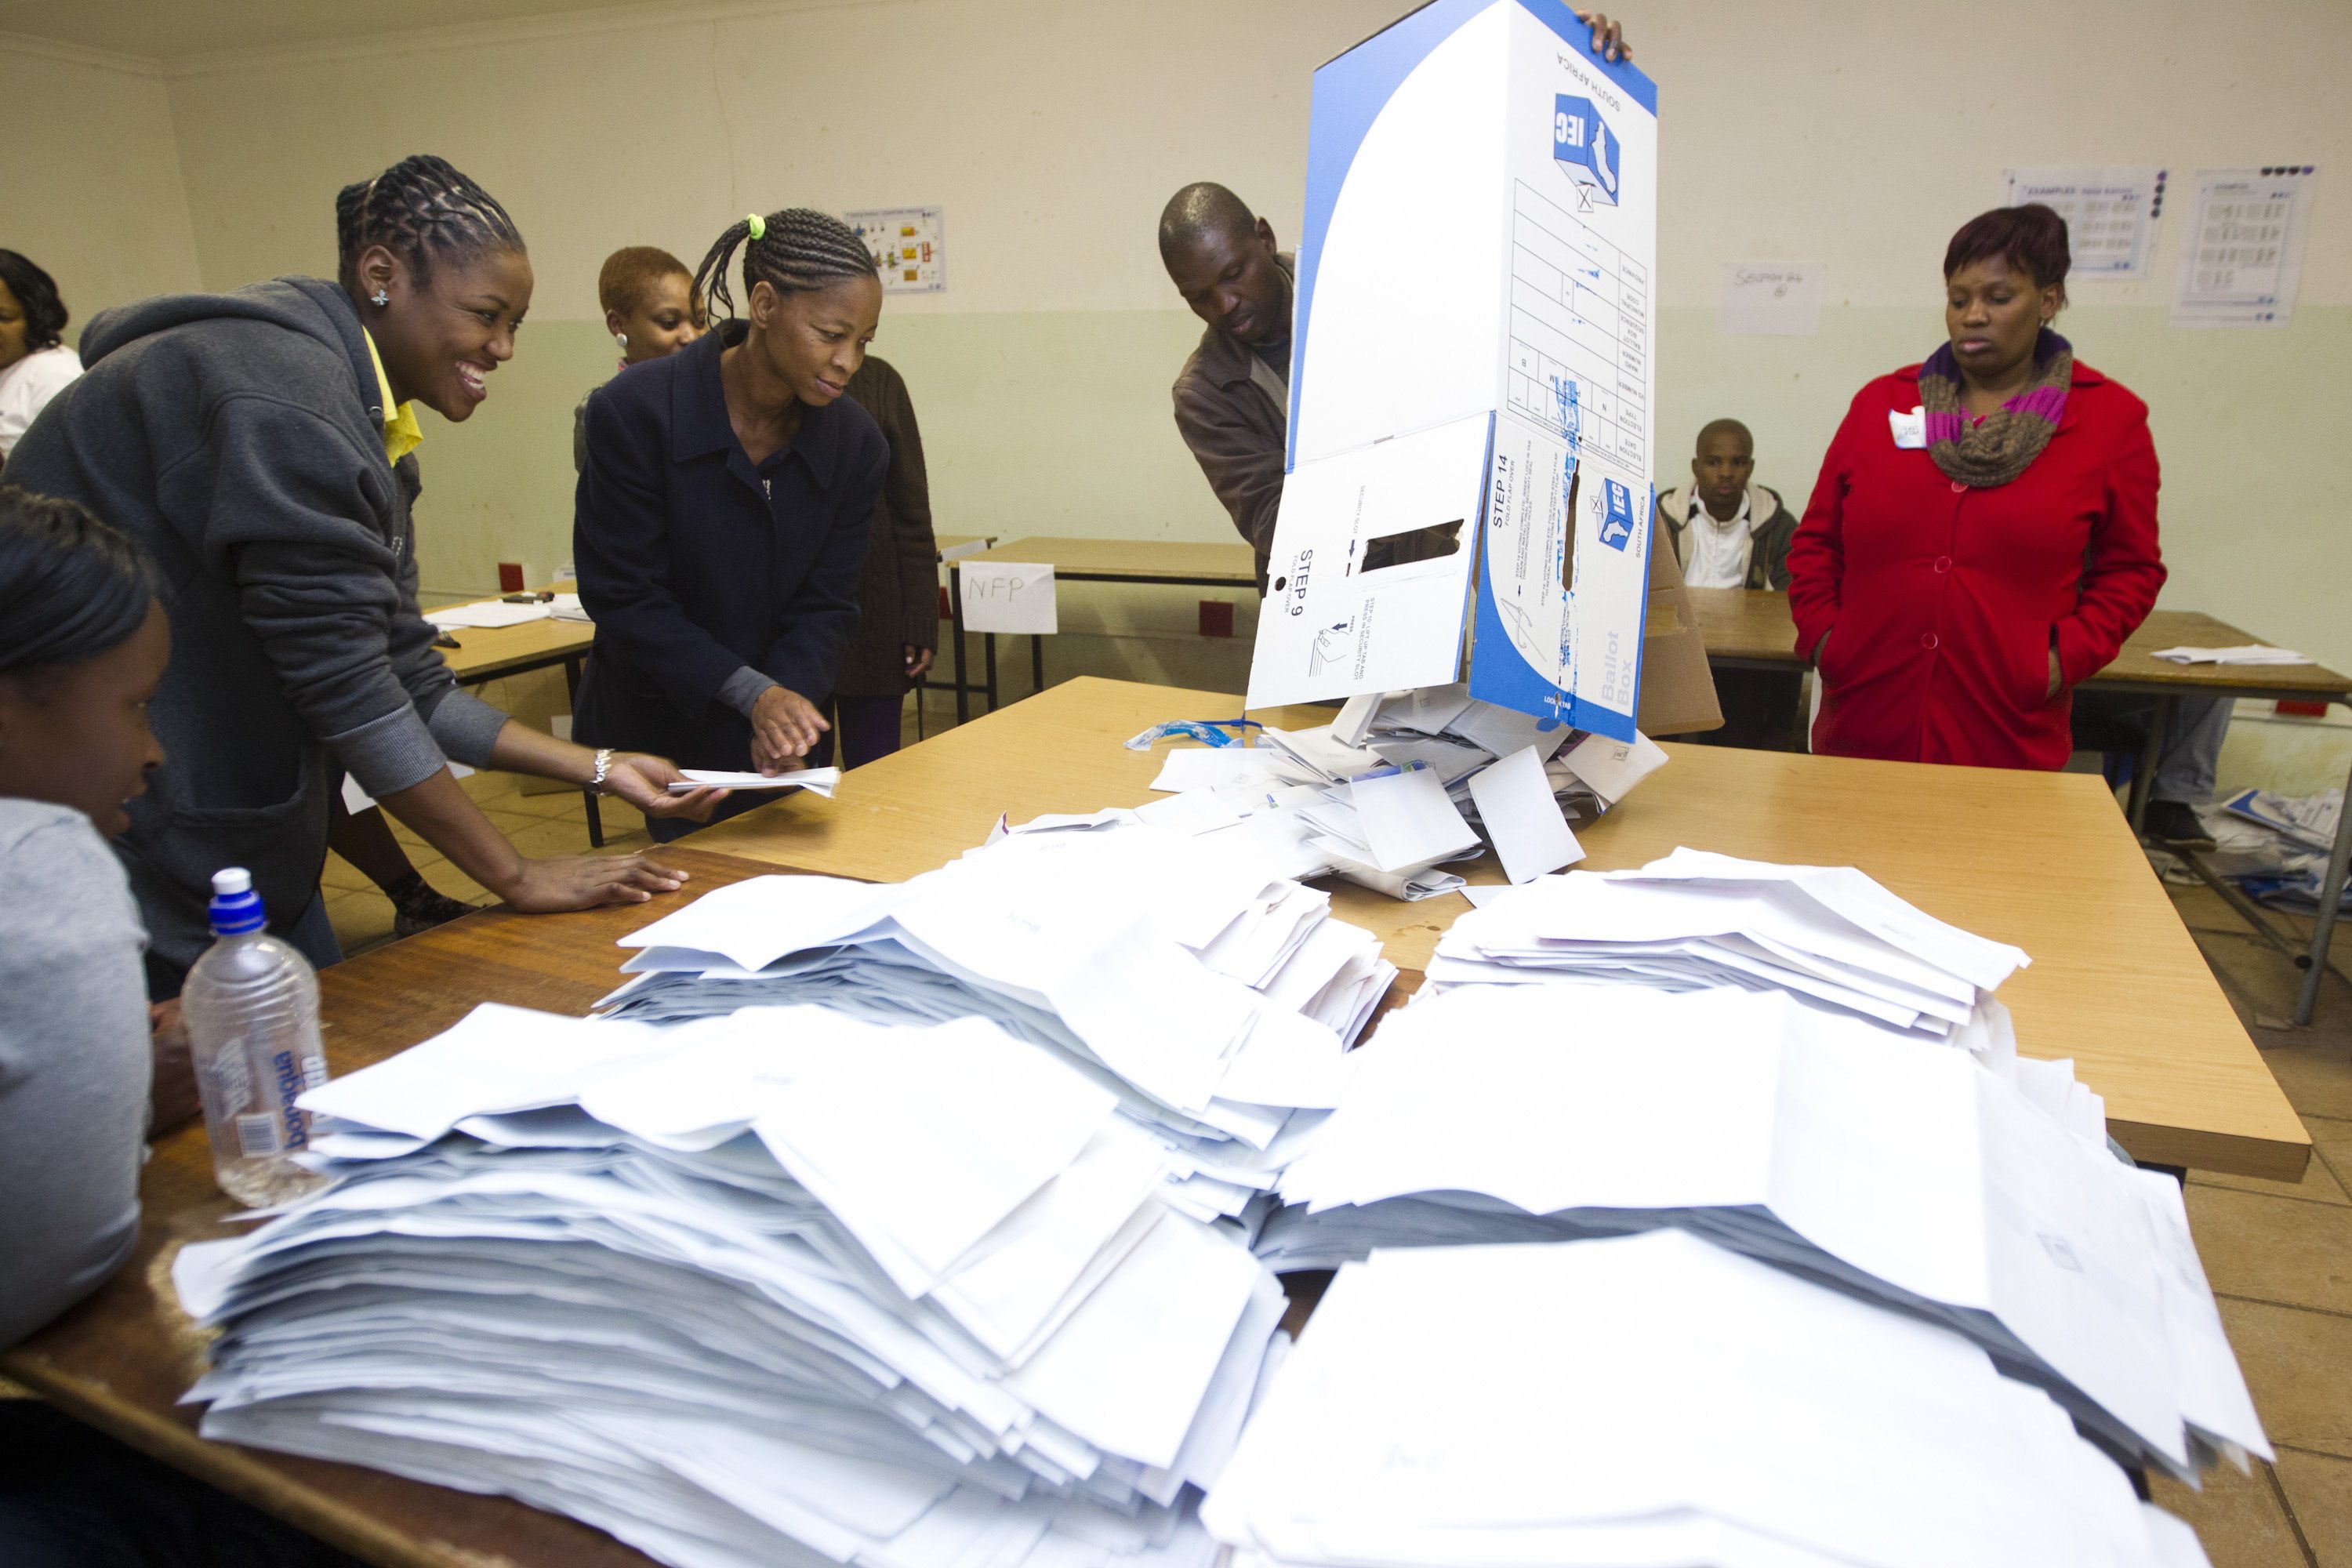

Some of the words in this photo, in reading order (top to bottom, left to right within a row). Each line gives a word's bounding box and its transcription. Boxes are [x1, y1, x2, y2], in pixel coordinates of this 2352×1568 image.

[1557, 52, 1589, 85] AFRICA
[1592, 81, 1621, 112] SOUTH
[1555, 112, 1584, 147] IEC
[1623, 336, 1641, 350] BALLOT
[1522, 358, 1526, 367] B
[1622, 350, 1641, 365] NUMBER
[1549, 374, 1554, 383] M
[1618, 381, 1637, 396] NUMBER
[1602, 403, 1607, 412] N
[1625, 408, 1636, 420] TYPE
[1620, 415, 1642, 433] ELECTION
[1624, 438, 1636, 450] DATE
[1619, 445, 1642, 462] ELECTION
[1498, 455, 1508, 474] 14
[1356, 485, 1365, 516] SECURITY
[1494, 480, 1504, 528] STEP
[1612, 483, 1626, 516] IEC
[1294, 550, 1313, 600] STEP
[969, 577, 1023, 603] NFP
[1291, 605, 1303, 616] 9
[1356, 630, 1365, 662] SECURITY
[1363, 641, 1368, 650] UP
[1602, 630, 1619, 702] Ballot
[1617, 659, 1632, 706] Box
[273, 1050, 307, 1150] bonaqua
